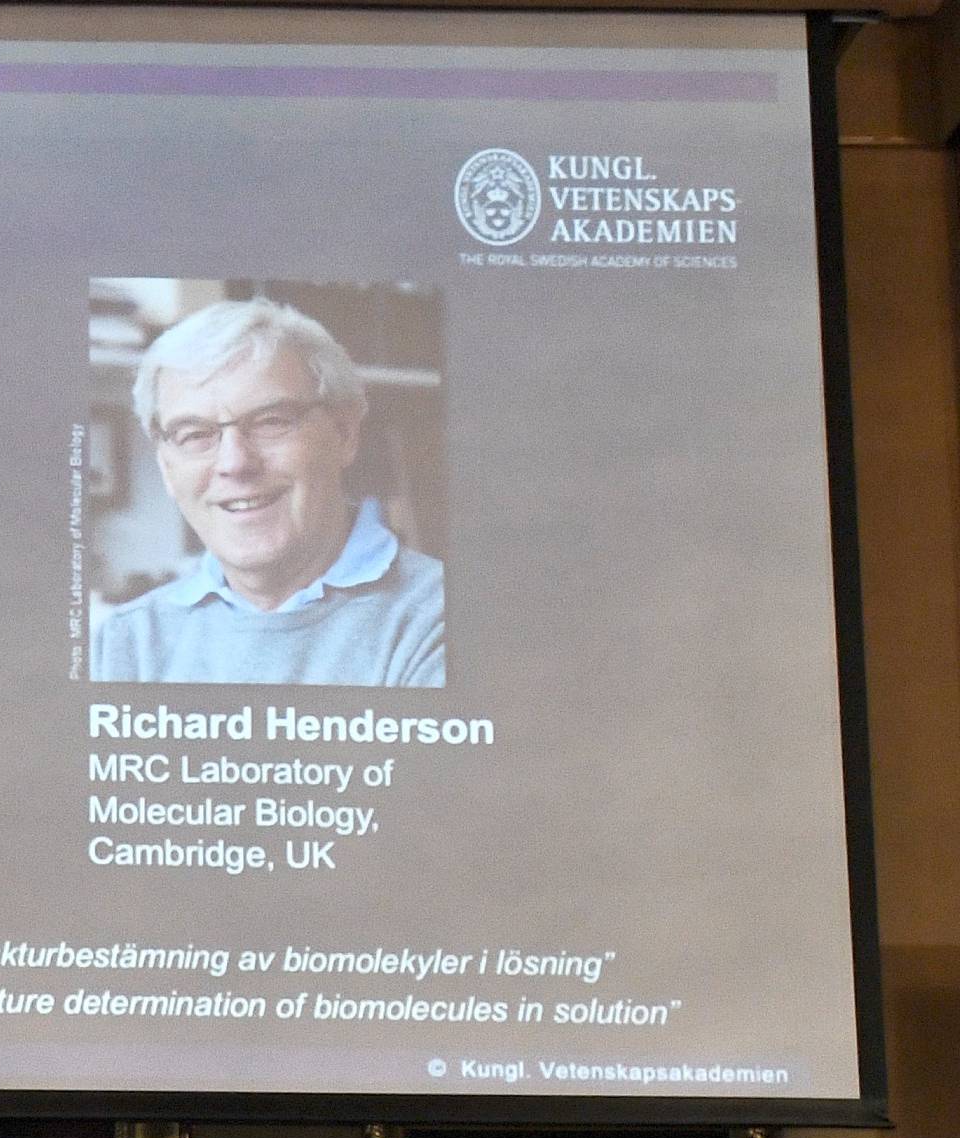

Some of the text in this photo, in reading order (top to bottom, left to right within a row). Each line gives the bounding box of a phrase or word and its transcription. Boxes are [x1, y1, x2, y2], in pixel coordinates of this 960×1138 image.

[550, 156, 656, 179] KUNGL.
[550, 187, 735, 211] VETENSKAPS
[551, 219, 735, 243] AKADEMIEN
[460, 254, 483, 266] THE
[90, 704, 493, 744] Richard Henderson
[90, 754, 394, 792] MRC Laboratory of
[90, 796, 378, 835] Molecular Biology,
[89, 837, 335, 874] Cambridge, UK
[239, 951, 275, 971] av
[284, 947, 472, 980] biomolekyler
[480, 950, 487, 974] i
[64, 989, 265, 1017] determination
[276, 993, 308, 1018] of
[314, 994, 507, 1022] biomolecules
[518, 997, 542, 1021] in
[461, 1060, 531, 1083] Kungl.
[540, 1062, 787, 1084] Vetenskapsakademien
